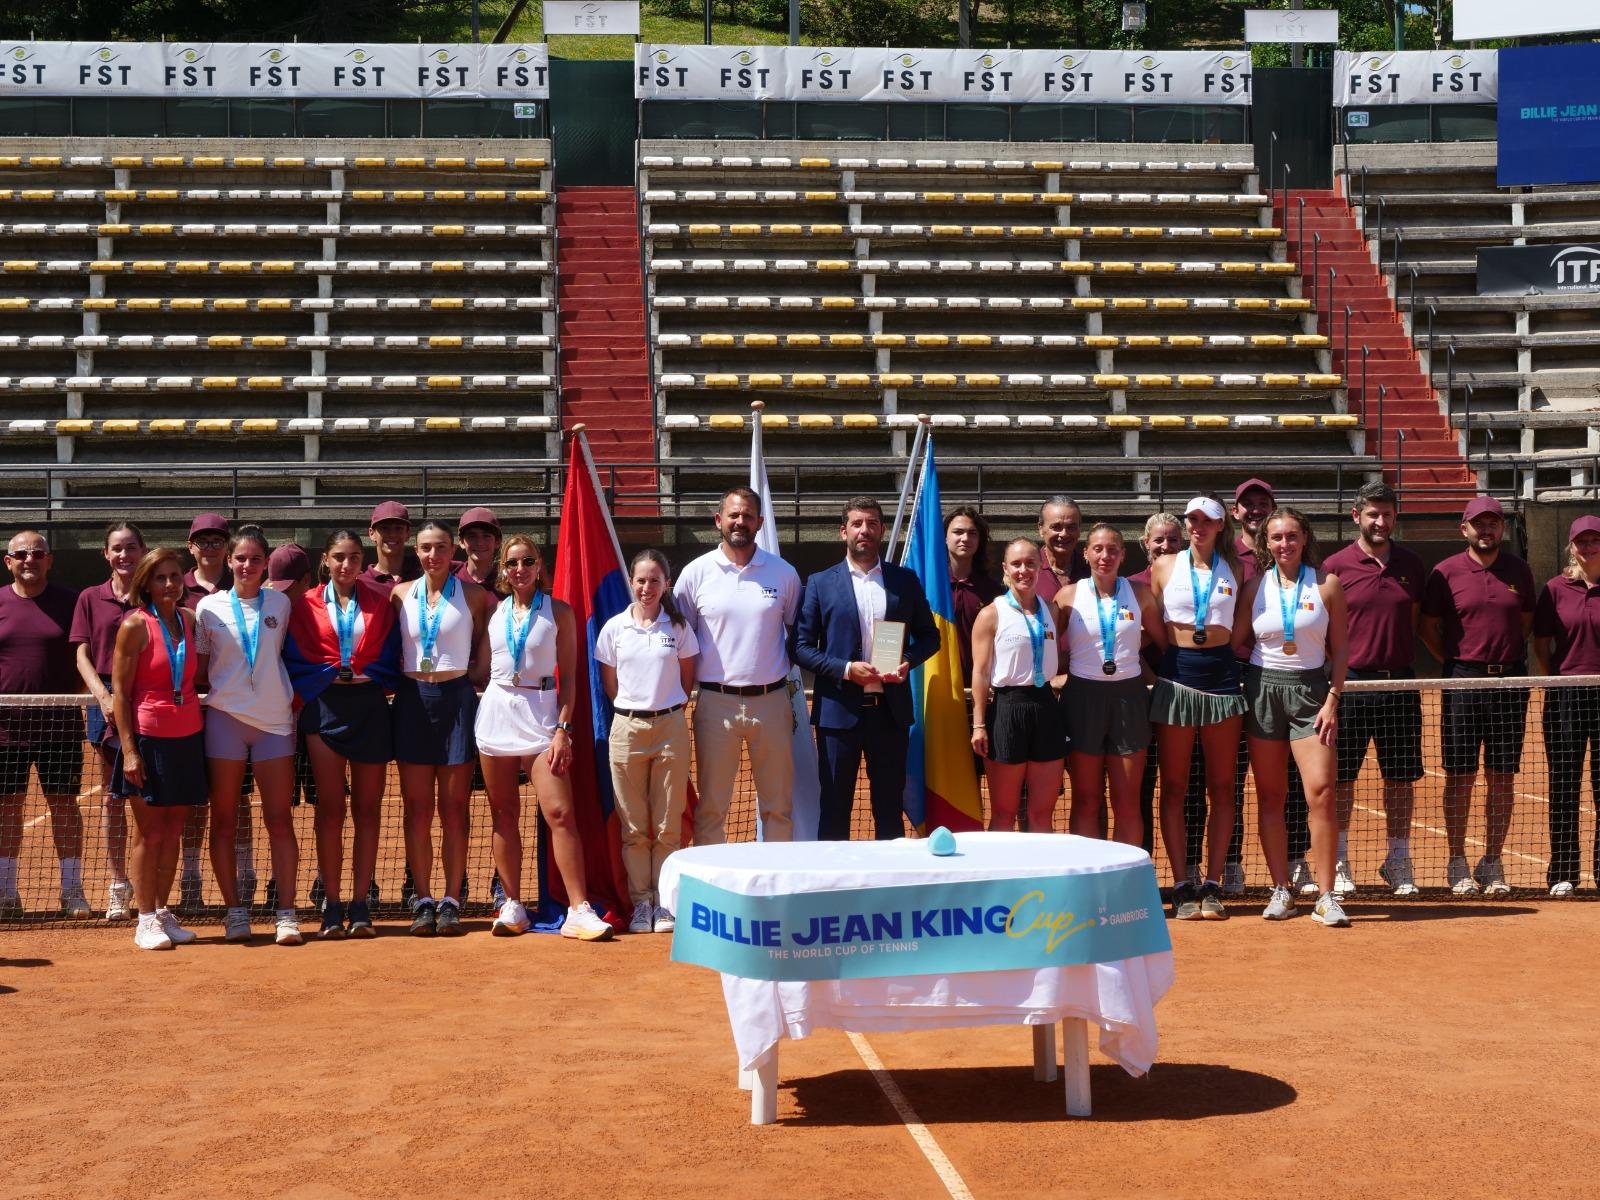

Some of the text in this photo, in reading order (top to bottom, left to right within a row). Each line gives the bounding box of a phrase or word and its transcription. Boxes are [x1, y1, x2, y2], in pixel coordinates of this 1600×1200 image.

[574, 15, 608, 28] FST
[80, 65, 131, 85] FST
[165, 66, 216, 86] FST
[250, 67, 300, 86] FST
[335, 67, 384, 86] FST
[419, 67, 468, 87] FST
[497, 67, 547, 87] FST
[639, 67, 688, 87] FST
[721, 69, 769, 88] FST
[802, 70, 851, 89] FST
[883, 71, 932, 90] FST
[965, 72, 1012, 91] FST
[1045, 73, 1092, 92] FST
[1125, 73, 1172, 92] FST
[1204, 74, 1251, 92] FST
[1351, 74, 1400, 94] FST
[1433, 73, 1481, 92] FST
[1520, 107, 1557, 119] BILLIE
[1560, 105, 1597, 117] JEAN
[691, 902, 782, 947] BILLIE
[791, 912, 903, 946] JEAN
[911, 905, 1014, 938] KING
[1005, 891, 1087, 954] Cup
[1109, 908, 1149, 926] GAINBRIDGE
[768, 941, 919, 960] THE WORLD CUP OF TENNIS
